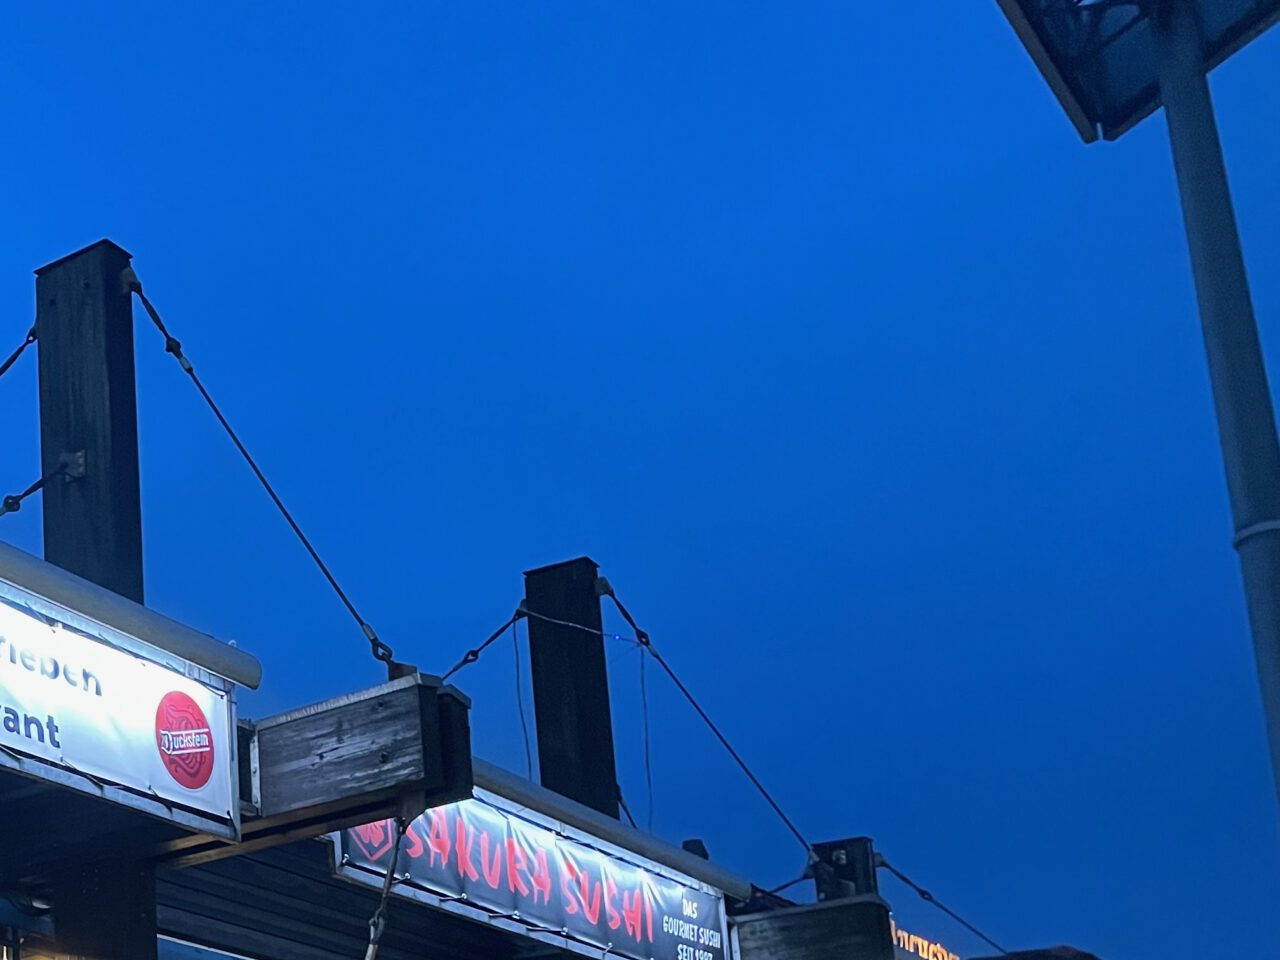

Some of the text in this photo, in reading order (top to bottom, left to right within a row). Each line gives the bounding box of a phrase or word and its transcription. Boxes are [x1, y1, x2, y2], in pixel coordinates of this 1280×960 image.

[160, 729, 210, 755] Duckstein
[405, 806, 654, 944] SAKURA SUSHI
[682, 898, 698, 919] DAS
[663, 915, 721, 949] GOURMET SUSHI
